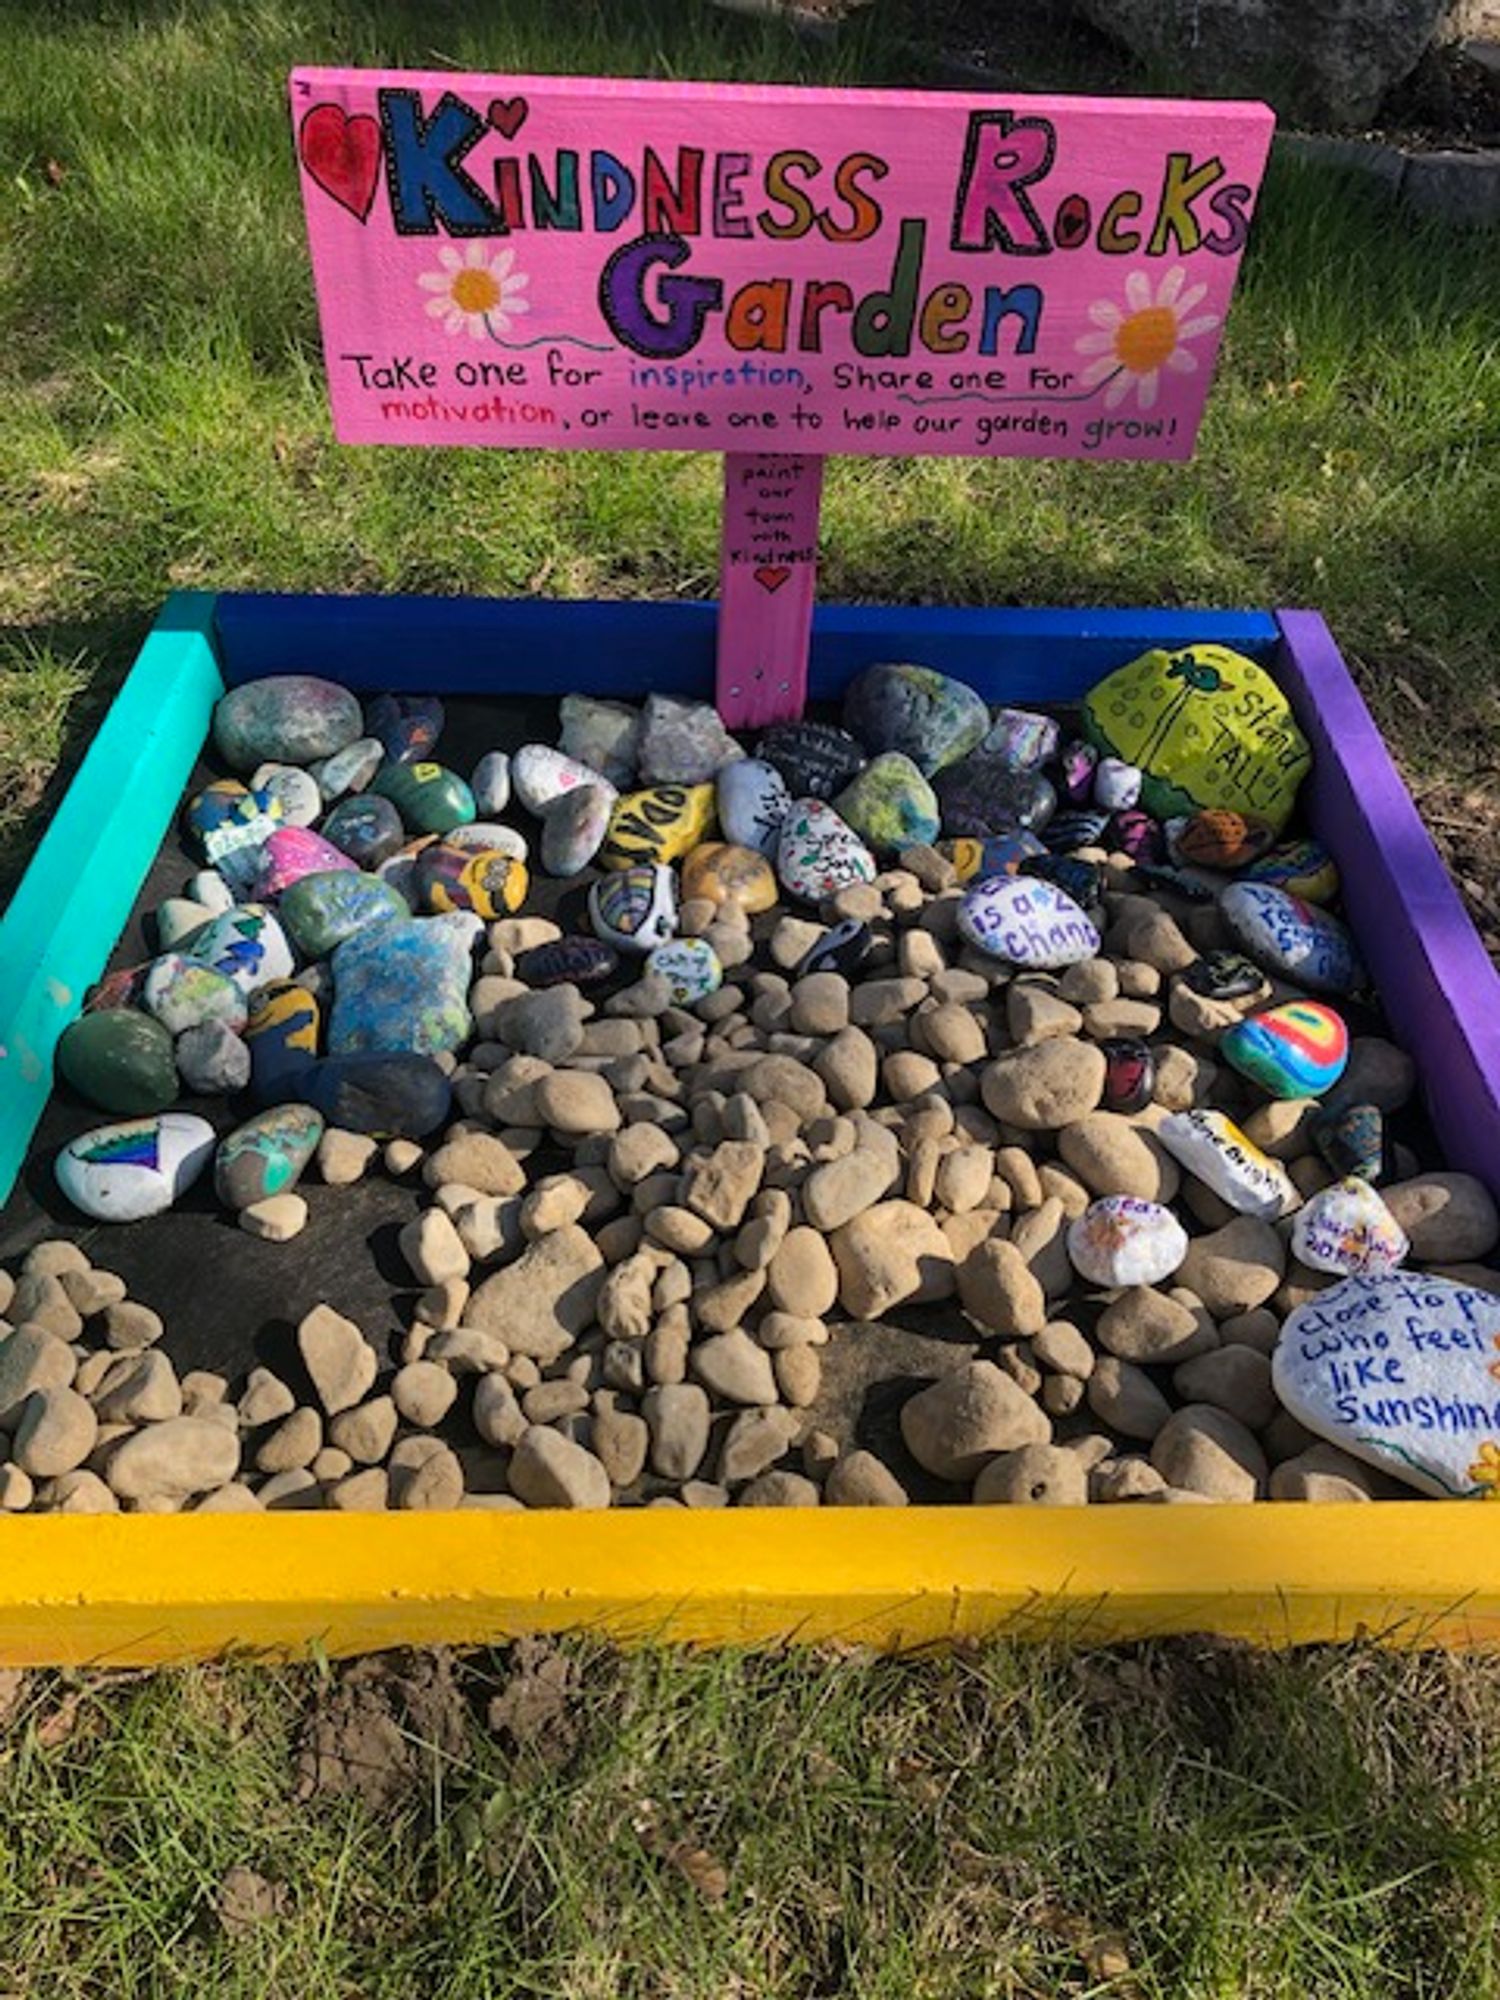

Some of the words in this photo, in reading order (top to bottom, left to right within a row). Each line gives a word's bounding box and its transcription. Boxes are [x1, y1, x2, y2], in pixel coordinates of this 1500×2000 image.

[598, 218, 1045, 360] Garden
[455, 361, 527, 387] one
[546, 349, 603, 387] for
[949, 369, 1006, 390] one
[580, 407, 614, 428] or
[632, 402, 711, 430] leave
[727, 409, 780, 429] one
[790, 404, 823, 431] to
[843, 406, 901, 432] help
[912, 413, 963, 434] our
[975, 408, 1068, 447] garden
[1081, 416, 1178, 450] grow!
[742, 461, 805, 486] paint
[758, 487, 794, 499] our
[745, 506, 794, 525] town
[751, 530, 792, 543] with
[1233, 689, 1306, 771] Stand
[968, 905, 1002, 935] is
[1012, 893, 1036, 917] a
[1396, 1283, 1444, 1310] to
[1301, 1330, 1390, 1362] who
[1406, 1316, 1485, 1354] feel
